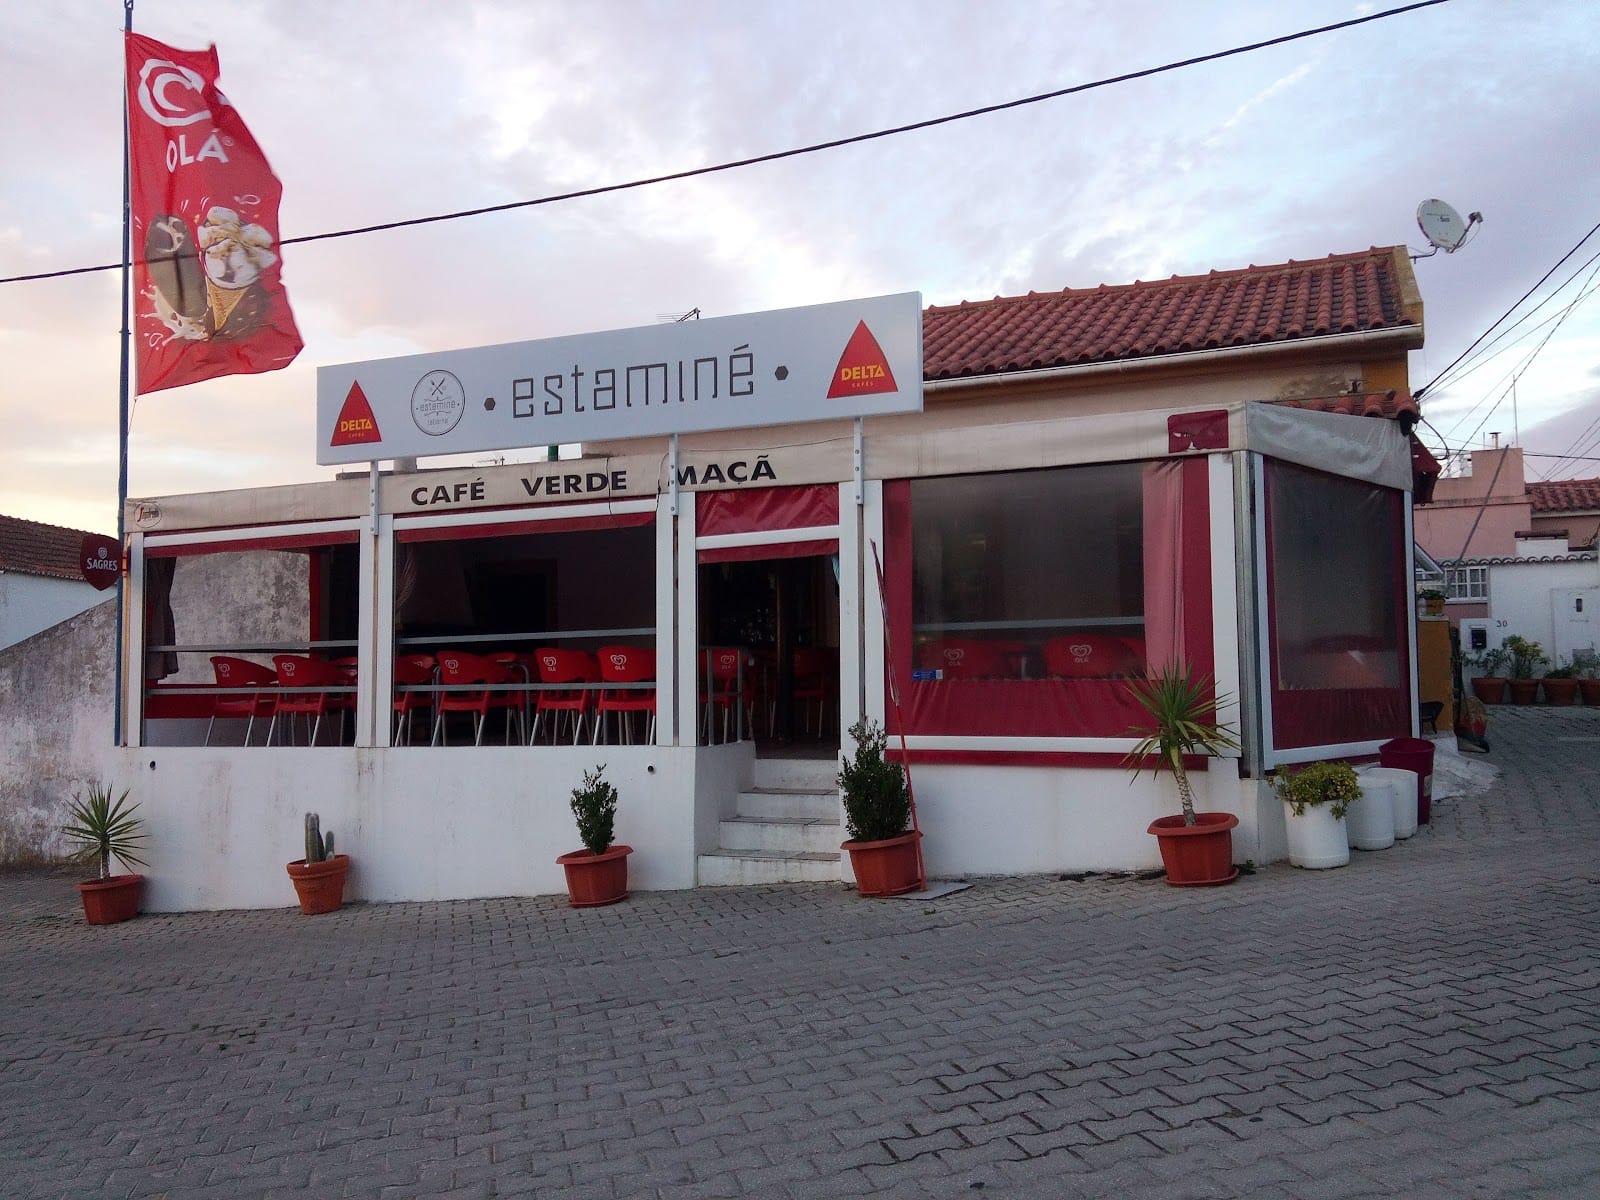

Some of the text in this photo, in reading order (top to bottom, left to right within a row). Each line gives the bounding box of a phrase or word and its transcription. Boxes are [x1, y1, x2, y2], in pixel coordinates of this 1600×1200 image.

[166, 128, 229, 173] OLÁ
[513, 344, 754, 418] estaminé
[841, 364, 885, 381] DELTA
[340, 418, 373, 432] DELTA
[411, 477, 485, 506] CAFÉ
[520, 470, 627, 497] VERDE
[86, 558, 118, 571] SAGRES
